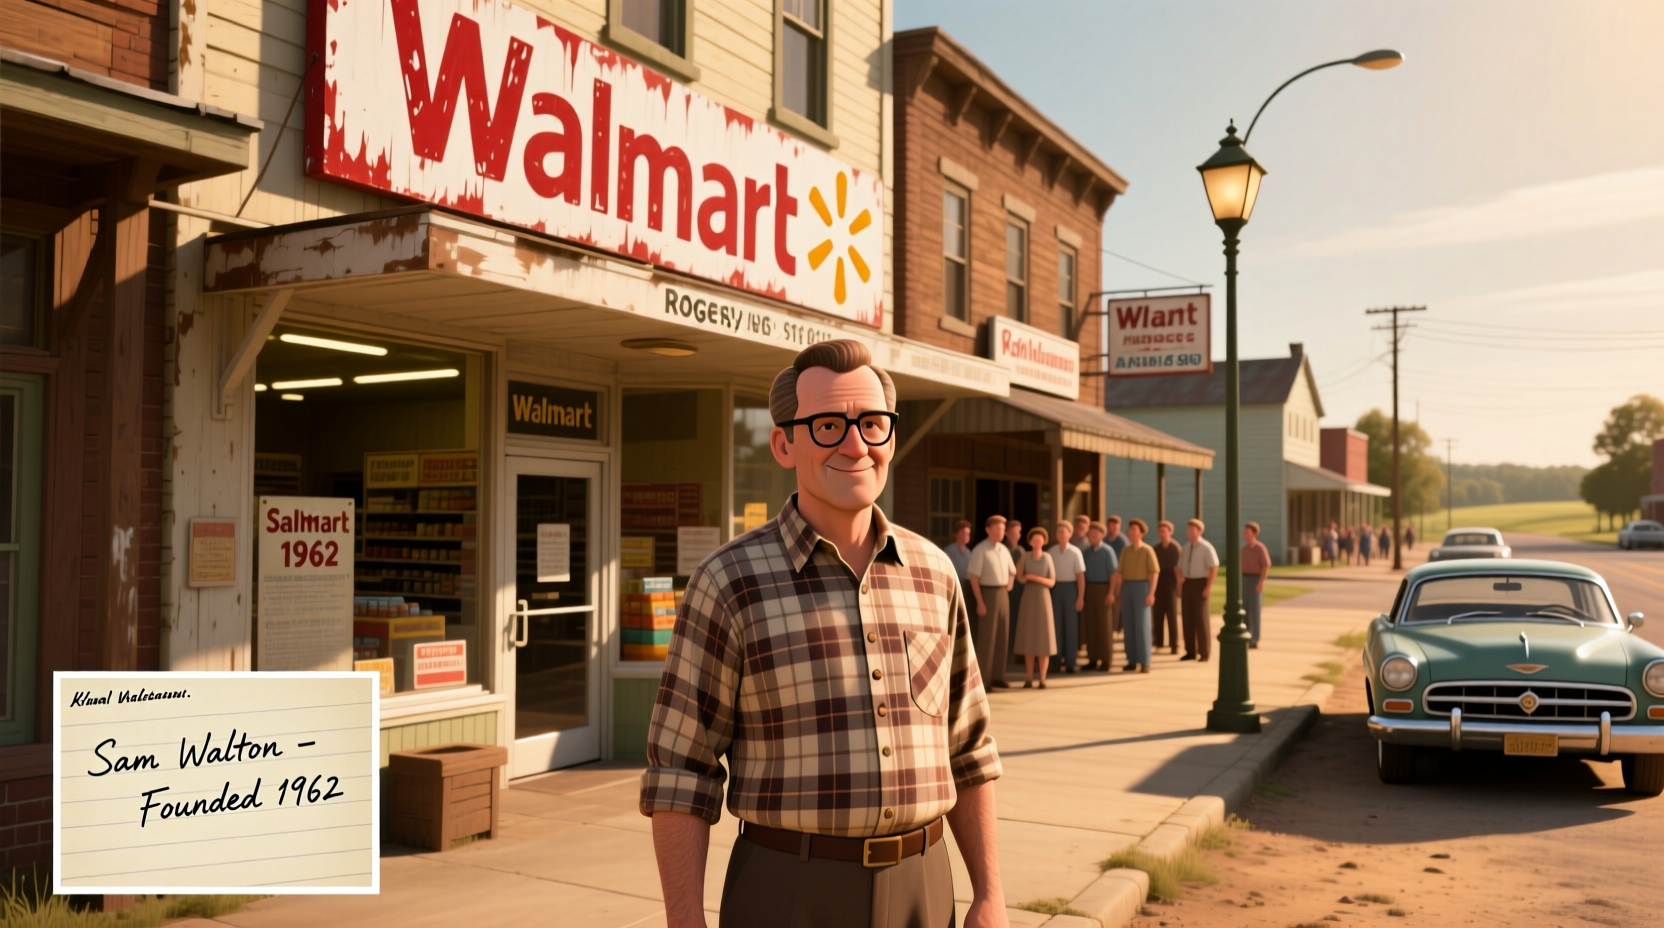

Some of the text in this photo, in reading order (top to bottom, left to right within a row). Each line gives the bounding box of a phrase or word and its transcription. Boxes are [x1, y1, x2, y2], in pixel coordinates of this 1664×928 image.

[390, 0, 798, 277] Walmart
[512, 394, 592, 429] Walmart
[281, 540, 339, 568] 1962
